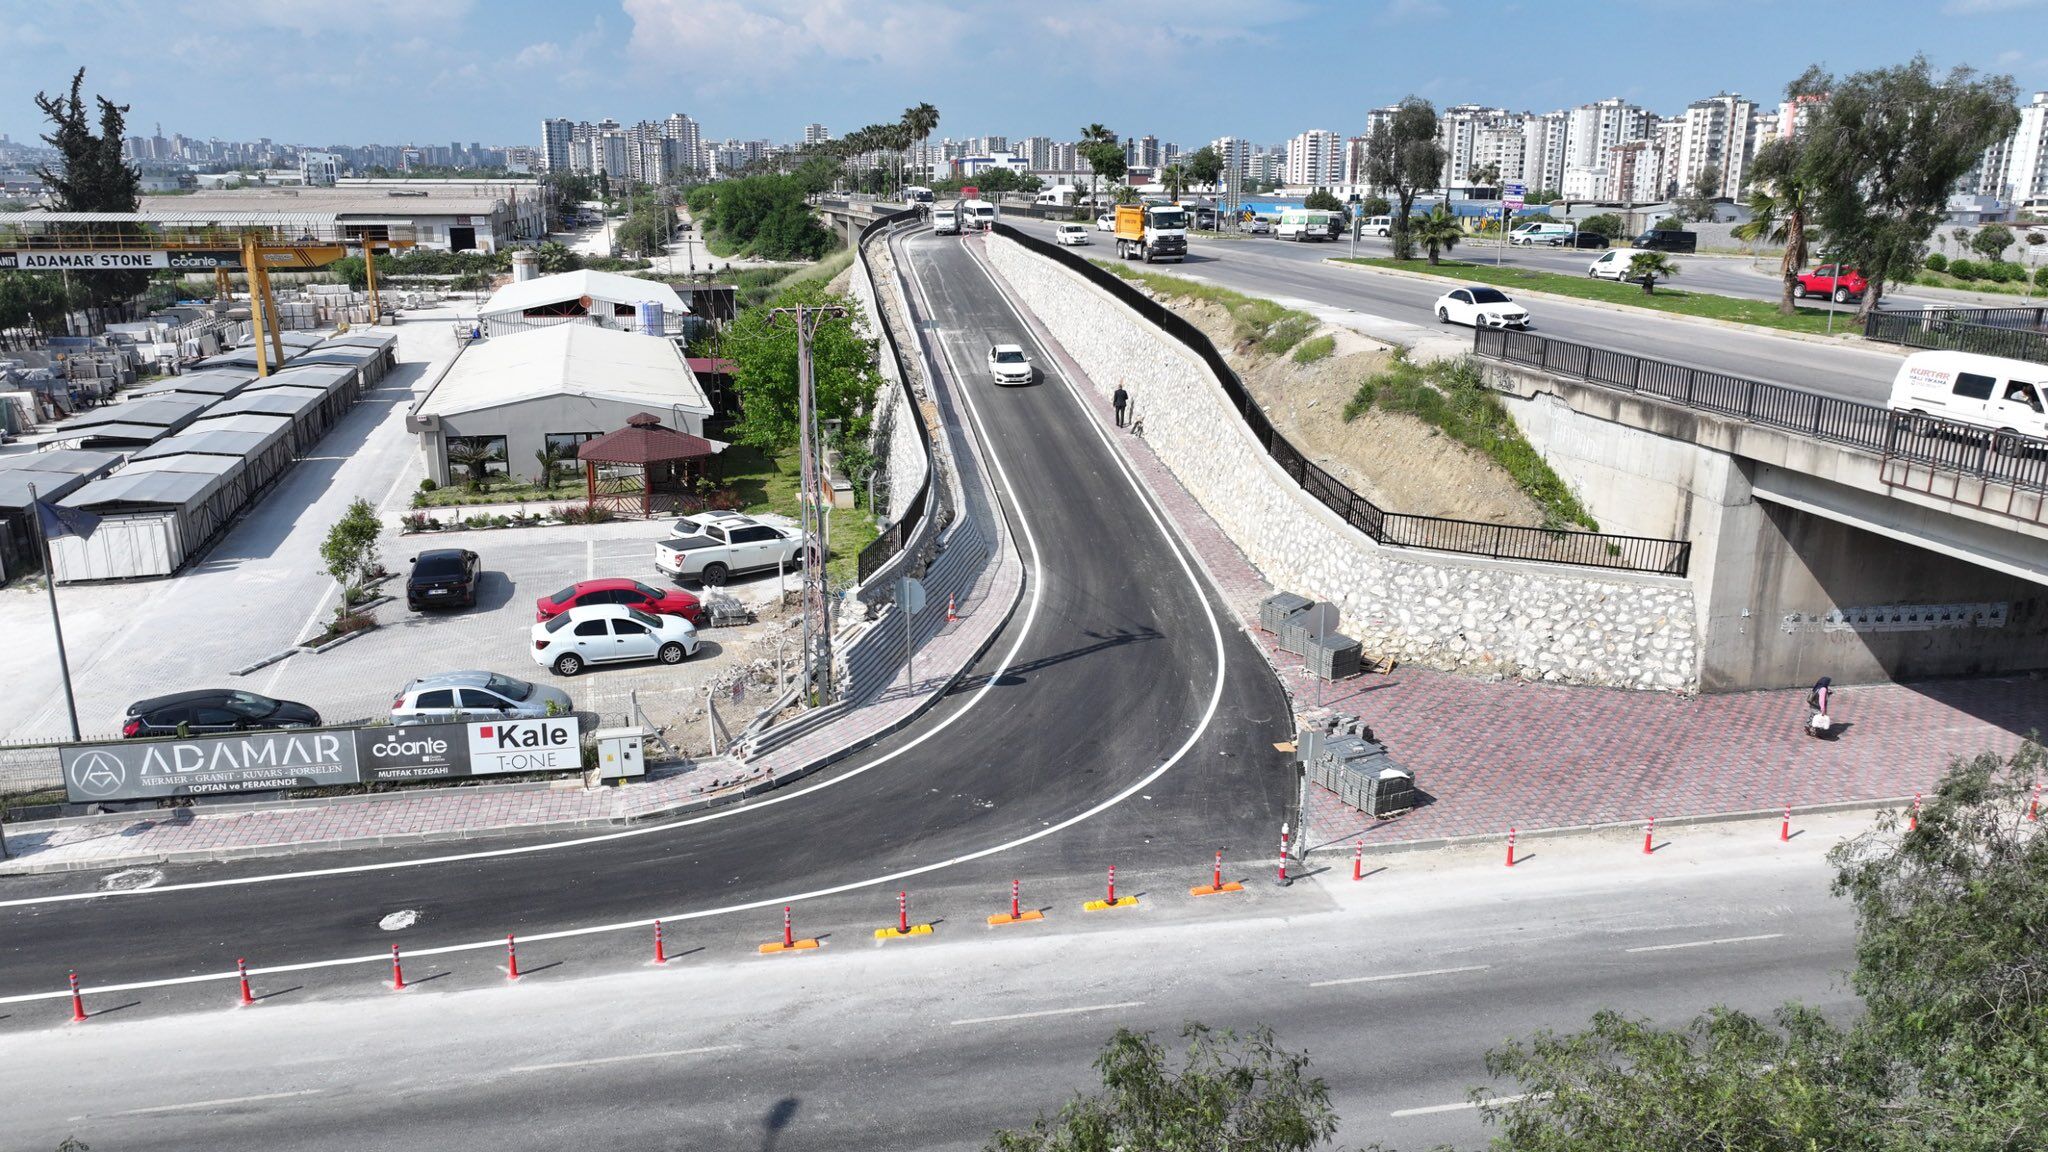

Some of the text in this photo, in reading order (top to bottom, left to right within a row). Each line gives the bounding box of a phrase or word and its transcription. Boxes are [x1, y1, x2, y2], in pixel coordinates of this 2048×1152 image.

[26, 254, 152, 267] ADAMAR STONE
[497, 722, 568, 749] Kale
[140, 734, 341, 775] ADAMAR
[372, 737, 448, 757] coante
[496, 752, 557, 771] T-ONE
[141, 775, 188, 787] MERMER
[242, 769, 283, 780] KUVARS
[290, 765, 343, 776] PORSELEN
[378, 767, 449, 778] MUTFAK TEZGAHI
[188, 778, 298, 794] TOPTAN ve PERAKENDE
